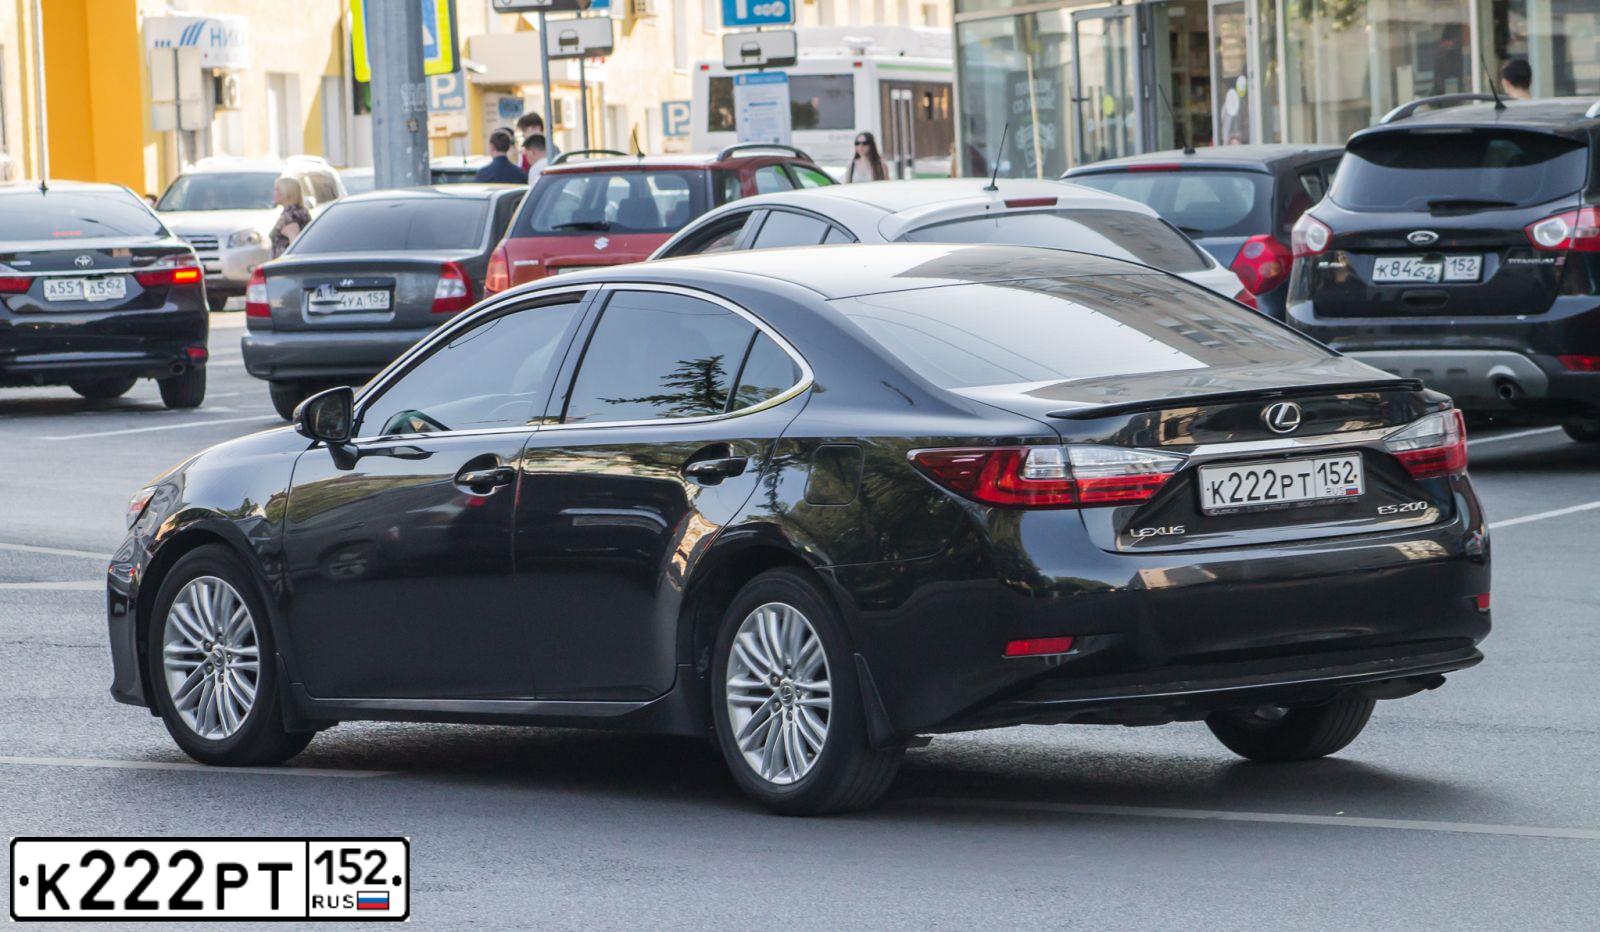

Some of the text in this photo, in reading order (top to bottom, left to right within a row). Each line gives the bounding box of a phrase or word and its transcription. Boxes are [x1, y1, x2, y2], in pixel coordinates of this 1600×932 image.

[1450, 258, 1475, 273] 152
[367, 291, 386, 304] 152
[1317, 460, 1355, 490] 152
[1325, 486, 1345, 496] RUS
[1377, 501, 1428, 515] ES 200
[1130, 525, 1186, 538] LEXUS
